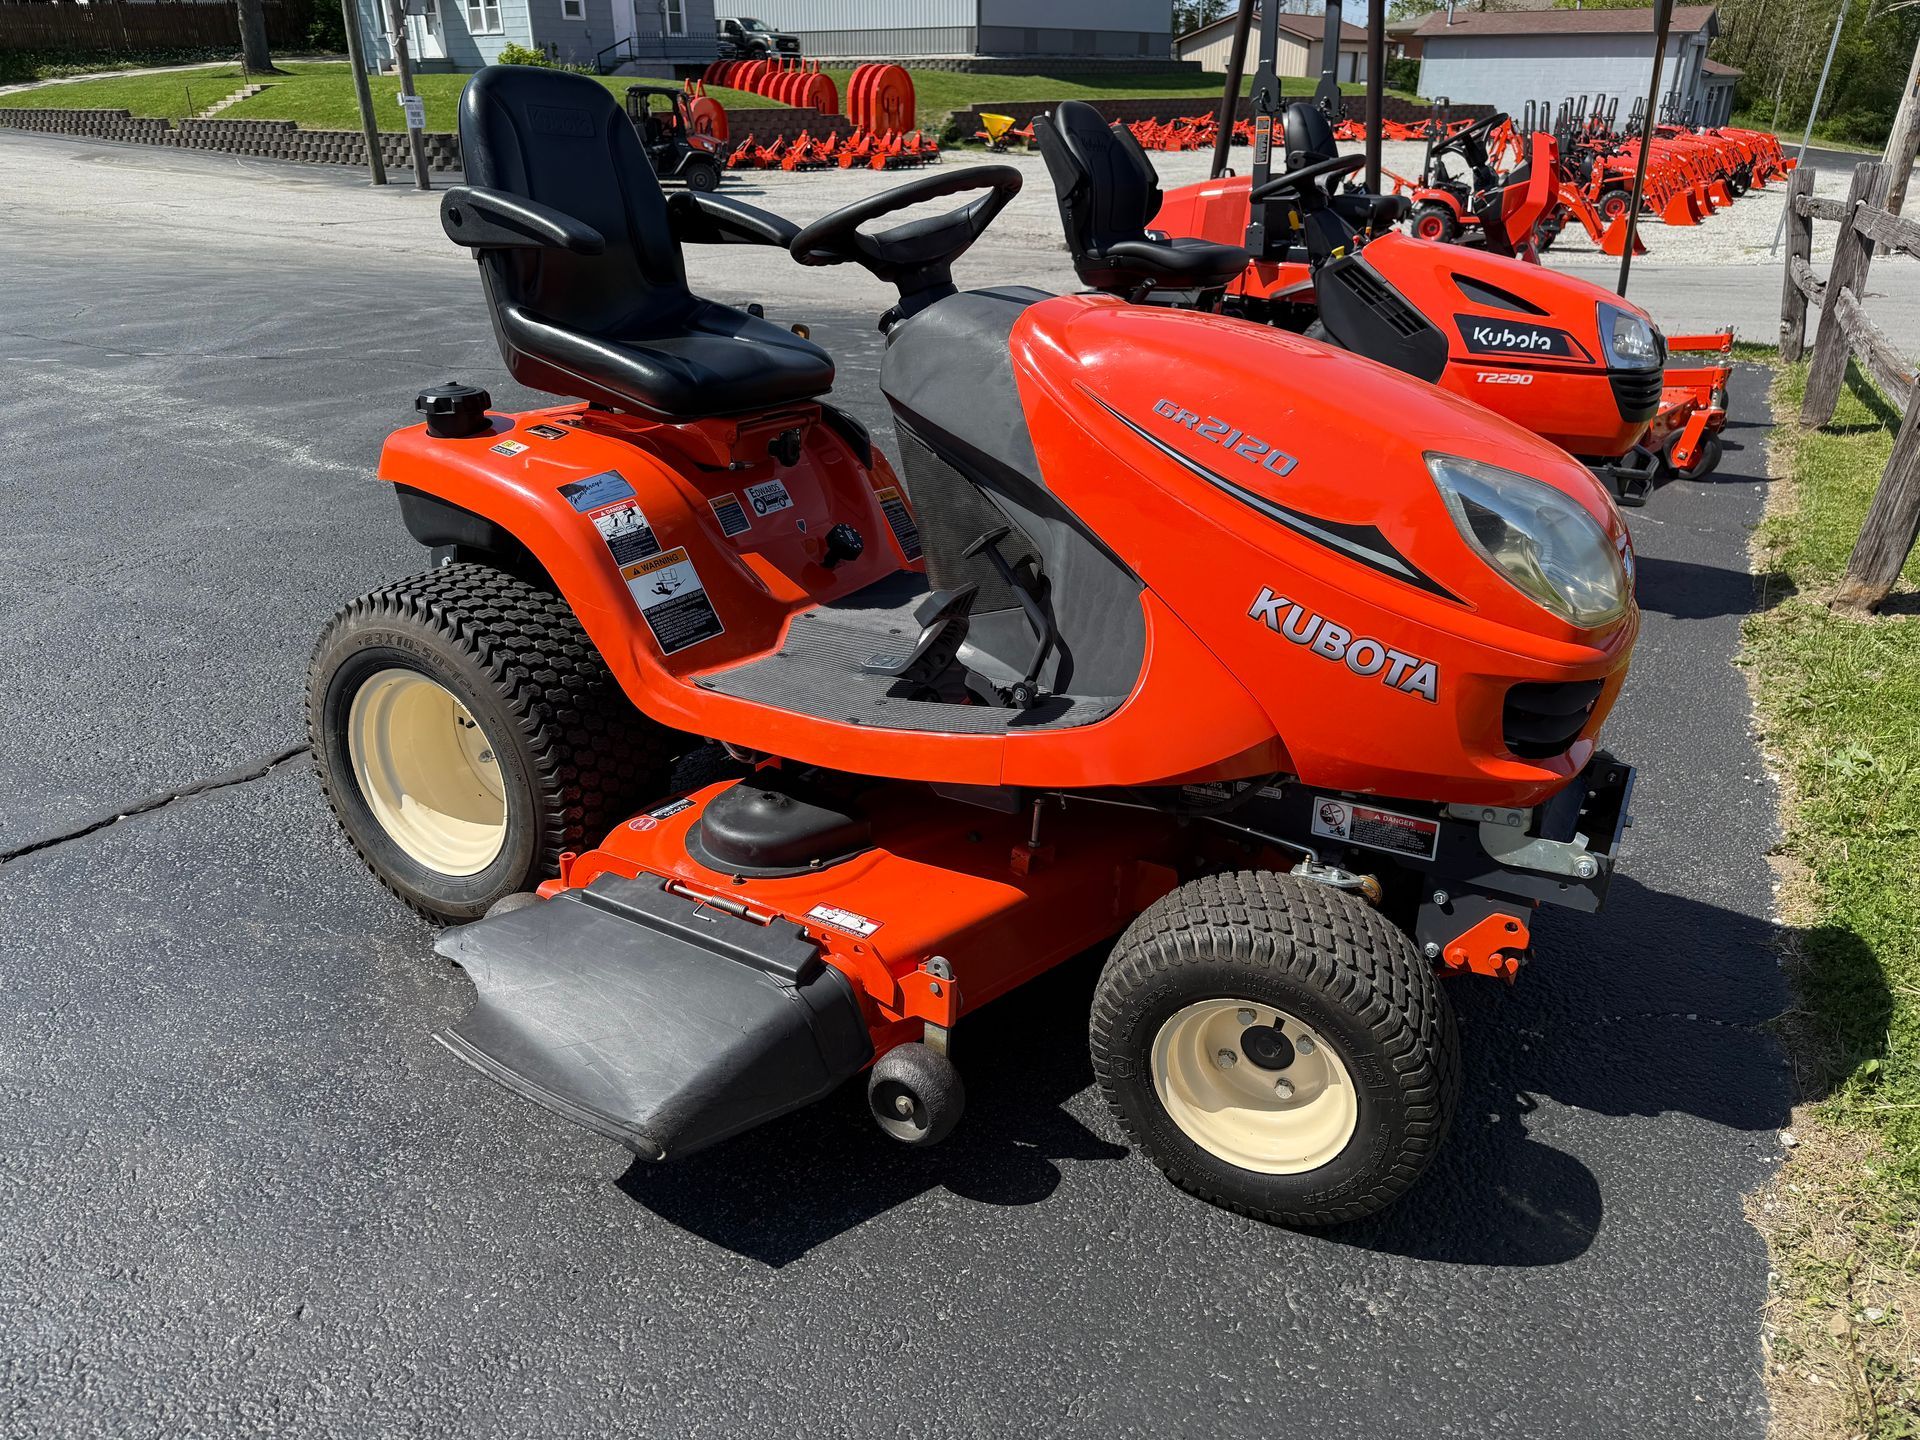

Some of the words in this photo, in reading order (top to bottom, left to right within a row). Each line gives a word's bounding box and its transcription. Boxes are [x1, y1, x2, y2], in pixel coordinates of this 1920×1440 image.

[1473, 326, 1552, 351] Kubota
[1476, 372, 1534, 385] T2290
[1152, 398, 1299, 478] GR2120
[605, 503, 629, 515] DANGER
[641, 553, 679, 572] WARNING
[1248, 585, 1440, 703] KUBOTA
[1383, 815, 1415, 828] DANGER
